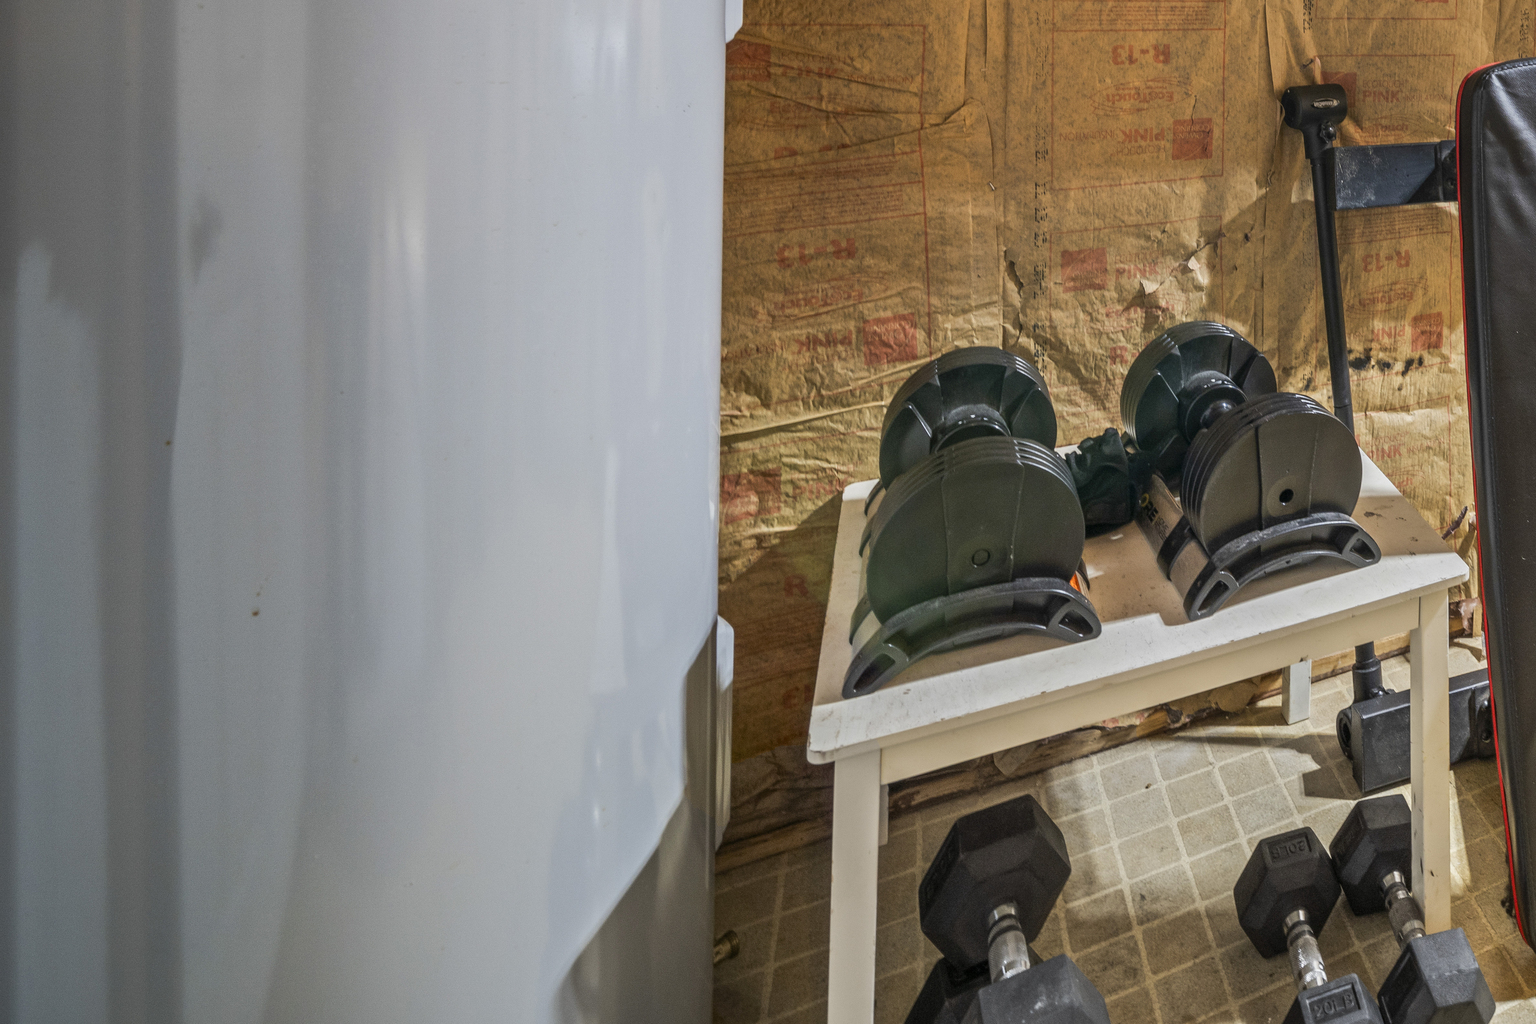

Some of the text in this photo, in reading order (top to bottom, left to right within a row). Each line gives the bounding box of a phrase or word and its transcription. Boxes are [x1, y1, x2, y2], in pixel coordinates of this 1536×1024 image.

[1111, 44, 1171, 65] R-13
[1106, 90, 1174, 104] EcoTouch
[1362, 89, 1400, 103] PINK
[1059, 127, 1166, 144] PINK INSULATION
[776, 238, 856, 269] R-13
[1362, 250, 1410, 273] R-13
[1116, 263, 1160, 281] PINK
[795, 330, 853, 355] PINK
